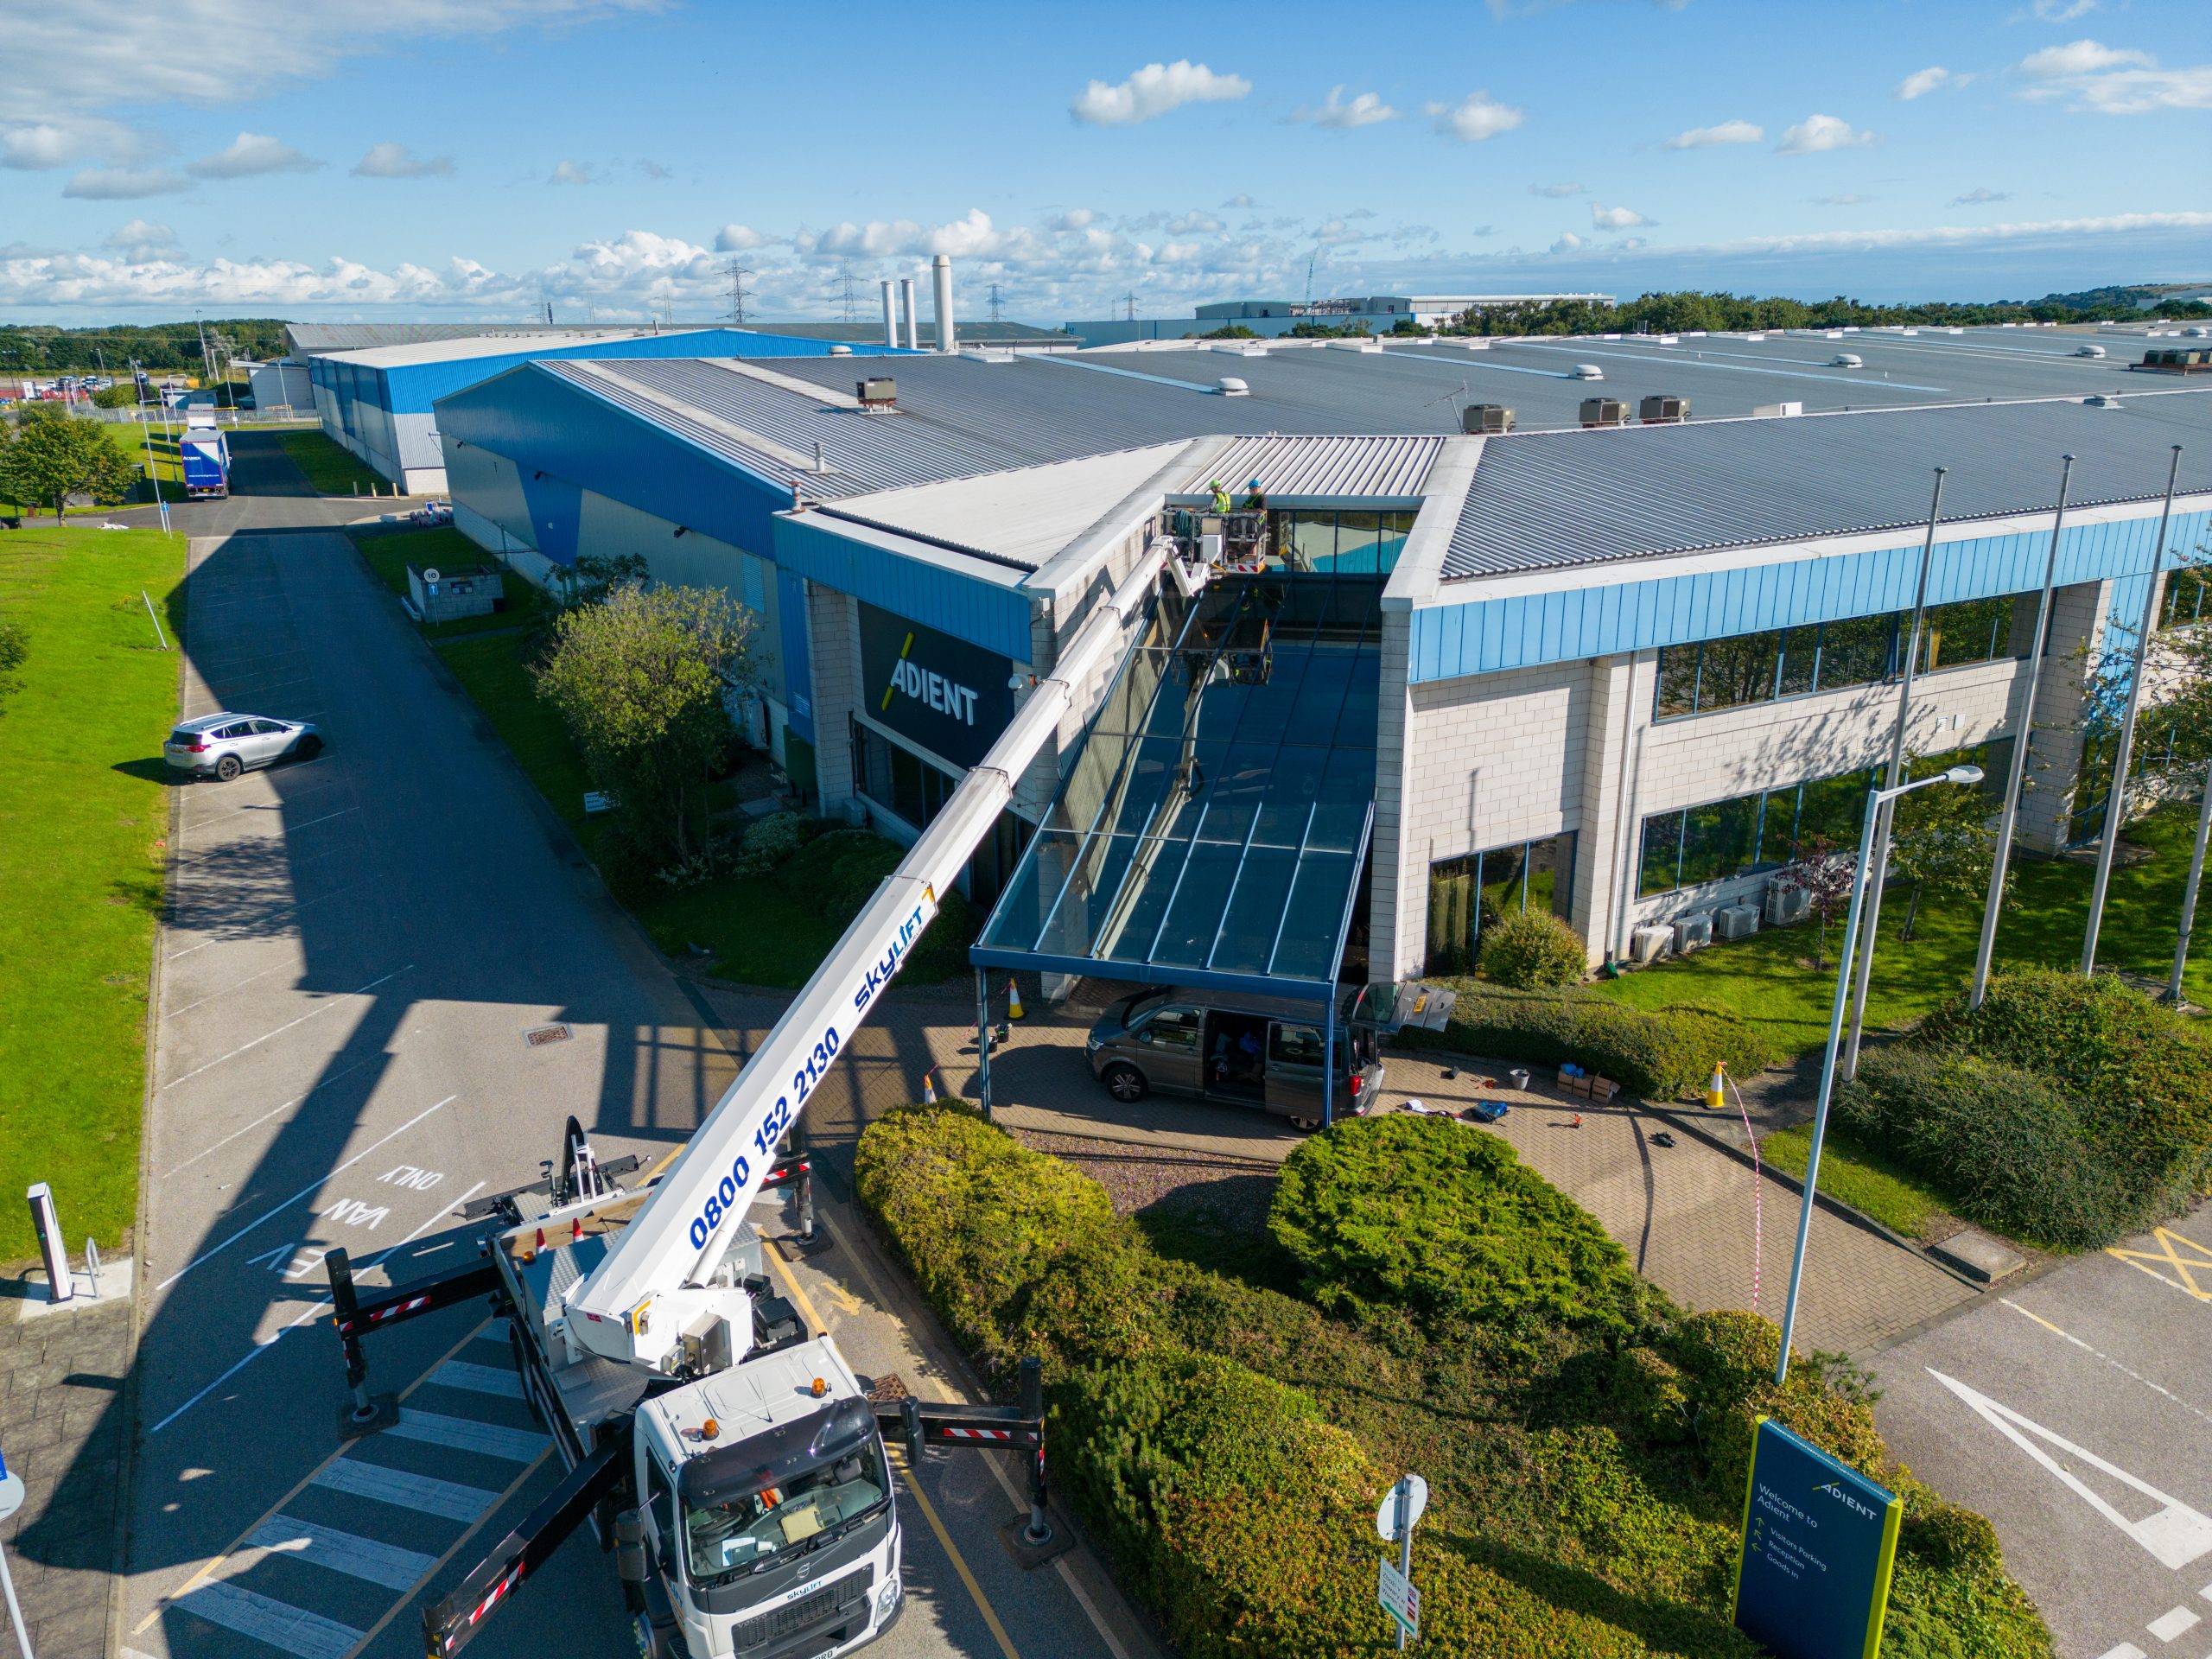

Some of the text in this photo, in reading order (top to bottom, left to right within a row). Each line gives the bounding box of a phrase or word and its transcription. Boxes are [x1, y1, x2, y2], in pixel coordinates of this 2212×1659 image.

[890, 658, 978, 726] ADIENT
[690, 1027, 839, 1250] 0800 152 2130
[376, 1166, 444, 1190] ONLY
[318, 1198, 391, 1230] VAN
[245, 1243, 327, 1279] EV
[1757, 1496, 1790, 1522] Adient
[1759, 1483, 1818, 1528] Welcome to
[1821, 1484, 1877, 1520] ADIENT
[1766, 1554, 1799, 1580] Goods in
[1768, 1541, 1805, 1570] Reception
[1770, 1528, 1827, 1572] Visitors Parking
[737, 1613, 767, 1629] VOLVO
